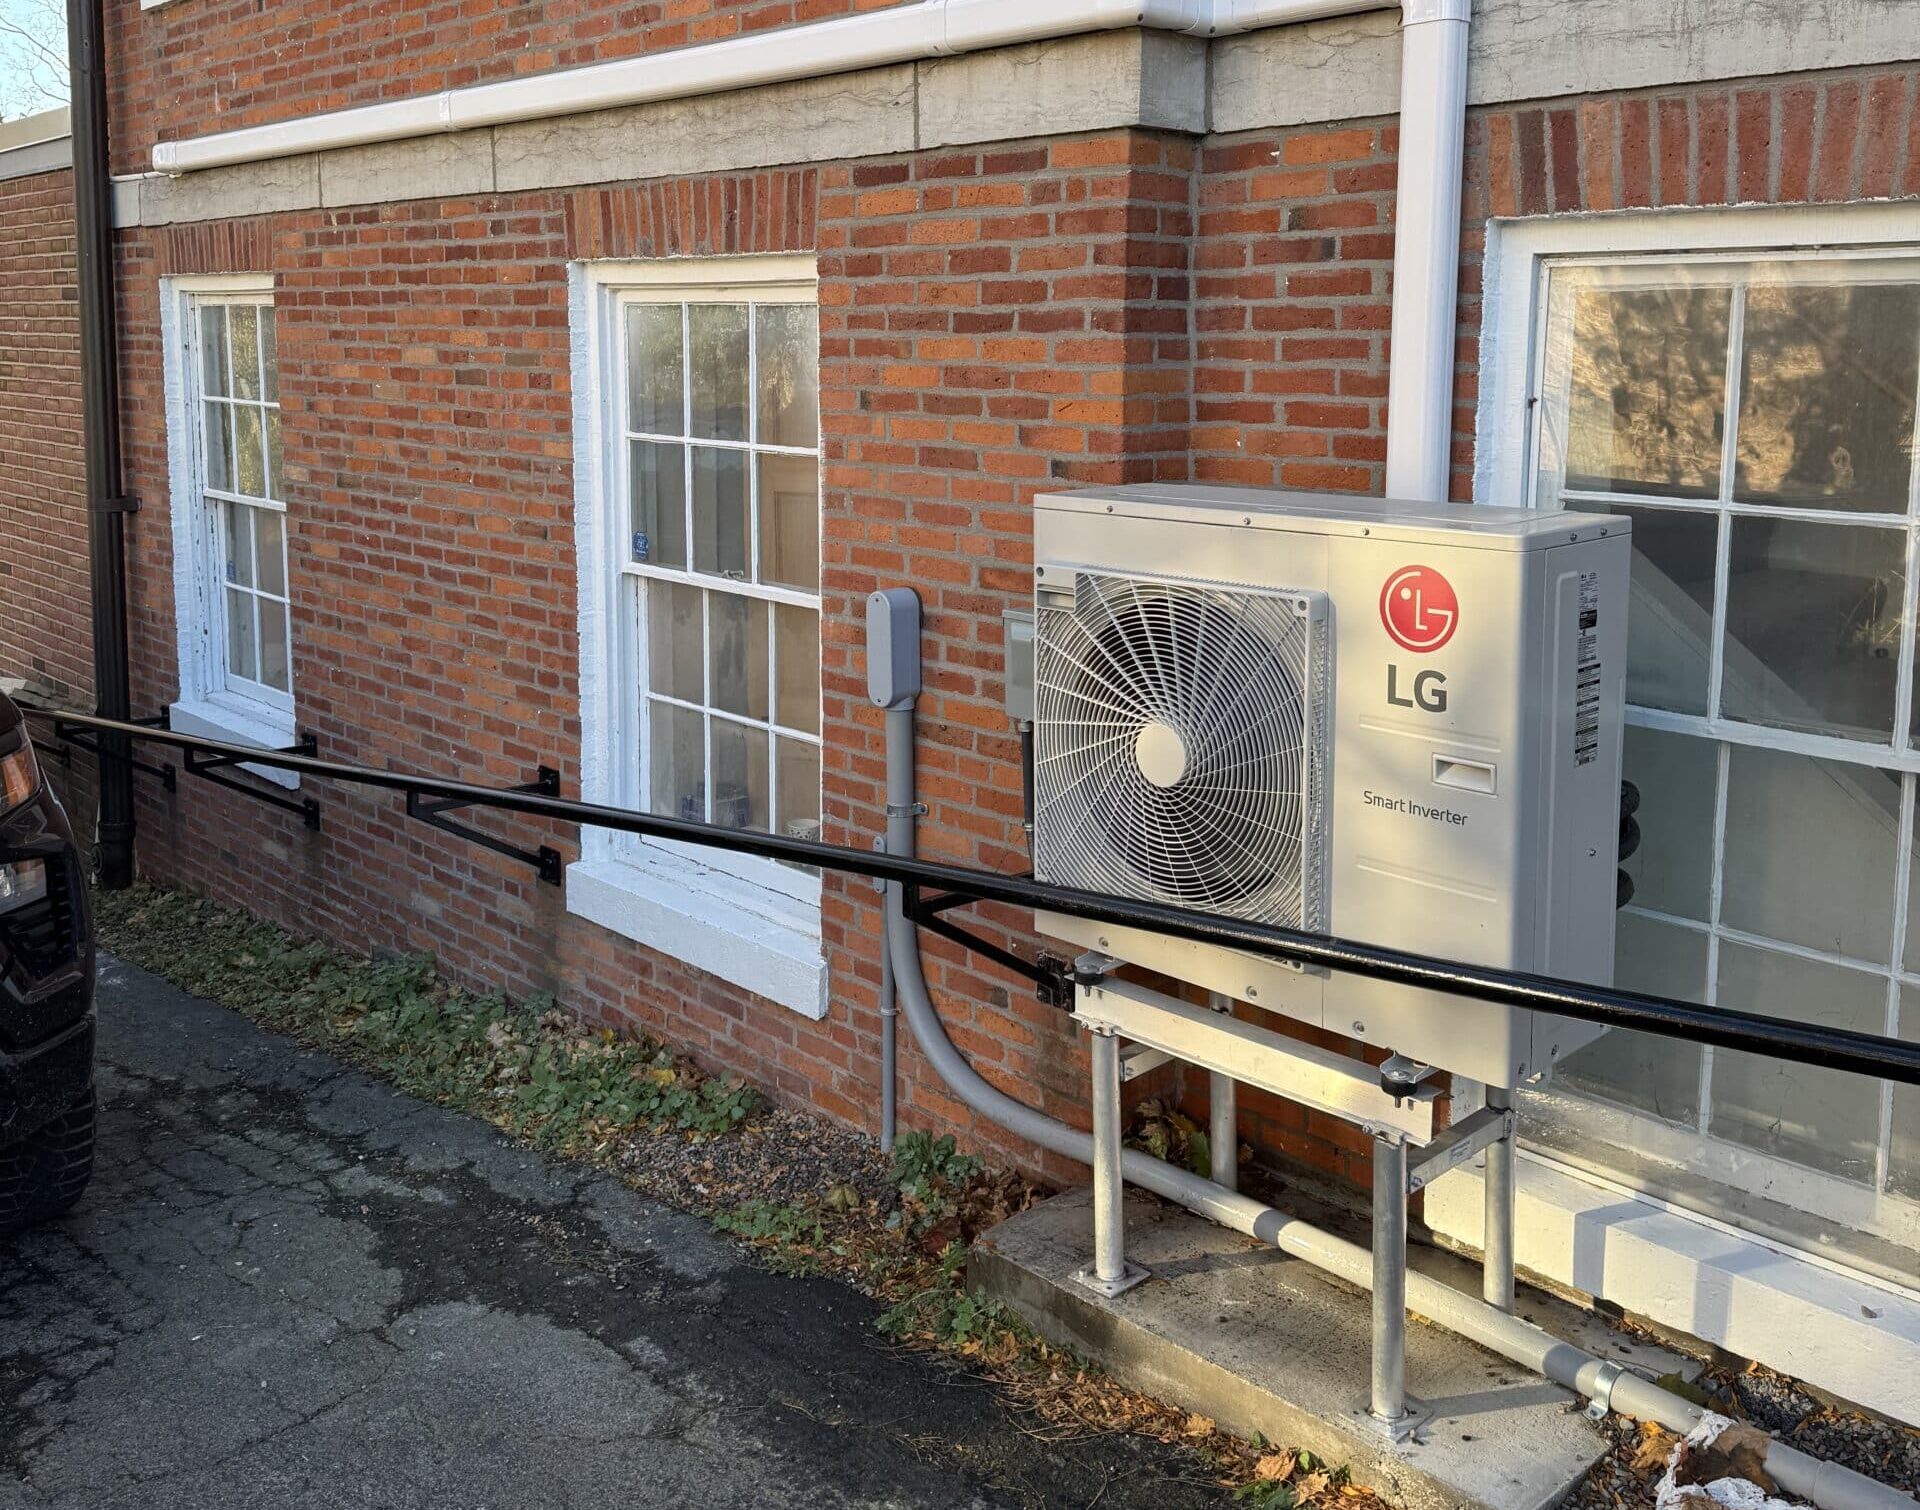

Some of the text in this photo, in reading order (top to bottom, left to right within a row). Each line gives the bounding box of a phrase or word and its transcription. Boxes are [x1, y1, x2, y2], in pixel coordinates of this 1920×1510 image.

[1387, 663, 1448, 713] LG
[1363, 790, 1469, 827] Smart Inverter
